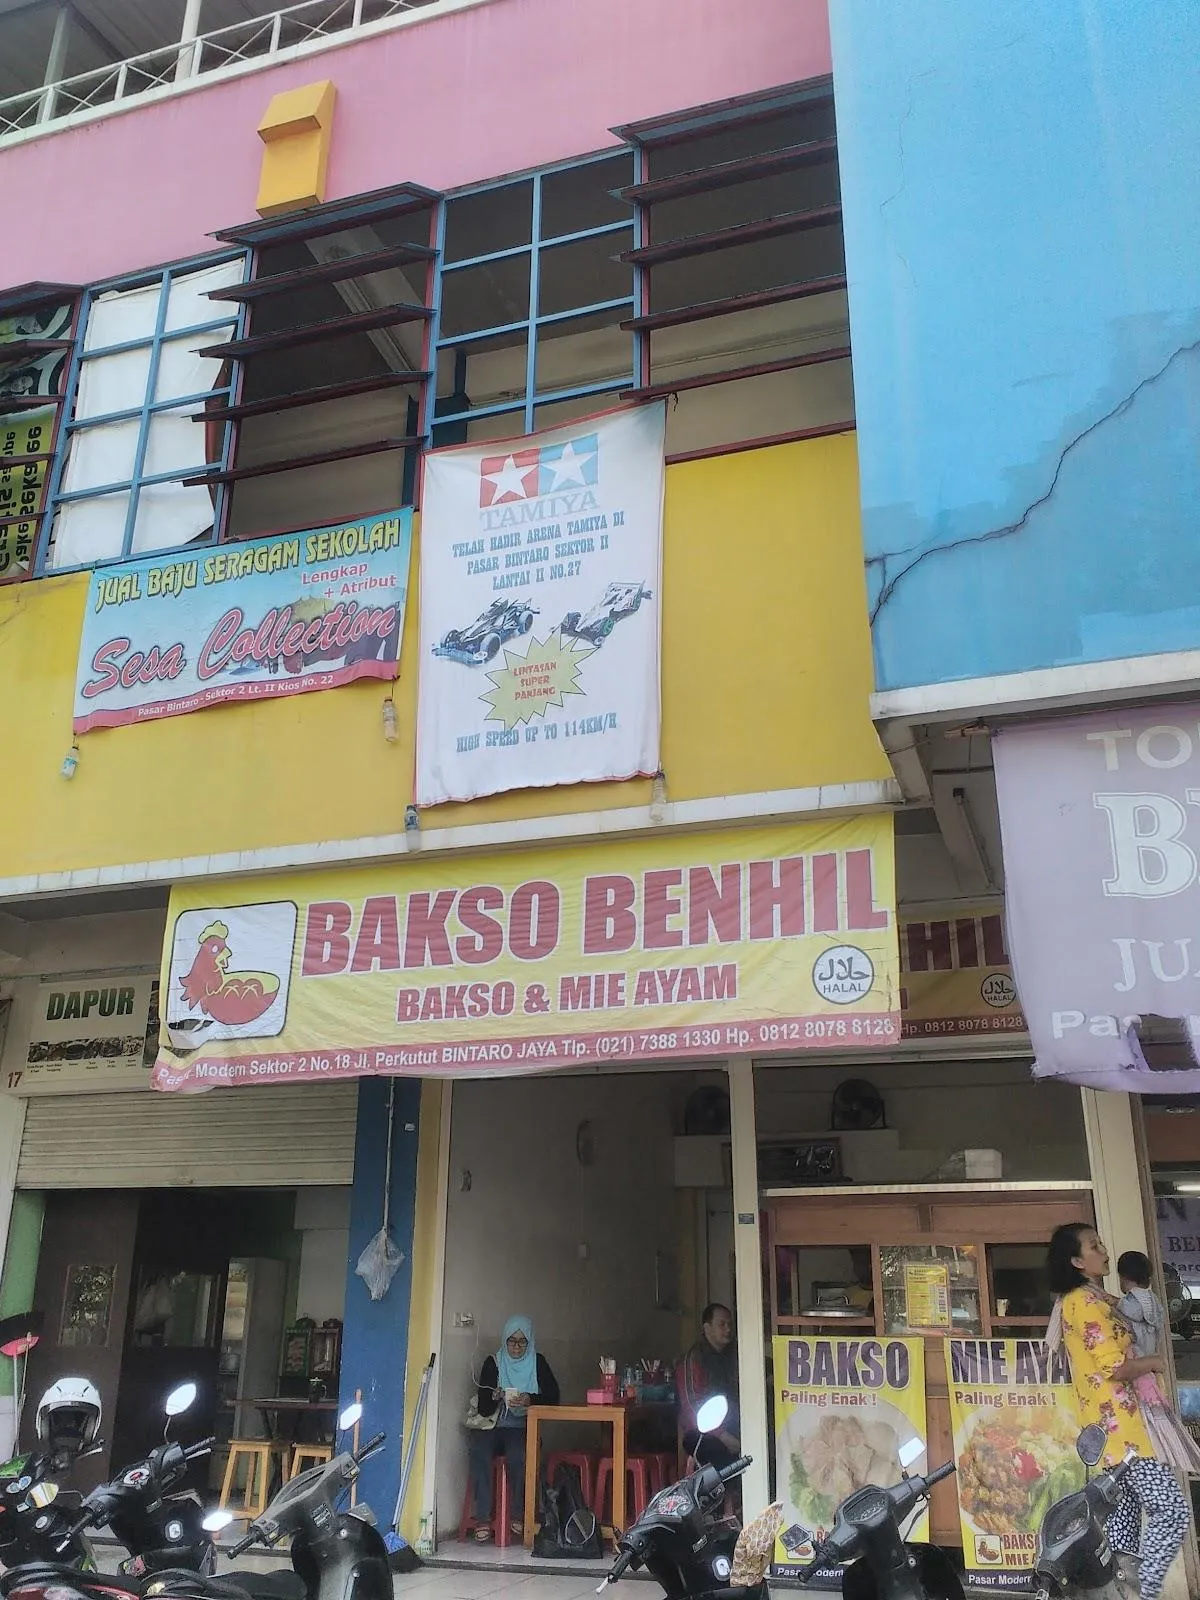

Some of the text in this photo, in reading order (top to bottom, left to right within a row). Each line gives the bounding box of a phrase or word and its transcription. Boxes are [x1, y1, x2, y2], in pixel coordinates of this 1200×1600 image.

[479, 490, 601, 531] TAMIYA
[452, 511, 625, 558] TELAH HADIR ARENA TAMIYA DI
[95, 518, 400, 614] JUAL BAJU SERAGAM SEKOLAH
[467, 534, 609, 575] PASAR BINTARO SEKTOR II
[302, 563, 368, 585] Lengkap
[340, 575, 397, 596] Atribut
[493, 560, 582, 590] LANTAI II NO.27
[82, 601, 397, 698] Sesa Collection
[513, 662, 557, 676] LINTASAN
[520, 675, 550, 687] SUPER
[138, 706, 164, 717] Pasar
[167, 699, 199, 712] Bintaro
[205, 687, 235, 700] Sektor
[238, 686, 245, 694] 2
[278, 682, 300, 692] Kios
[301, 676, 317, 687] No.
[321, 675, 334, 684] 22
[514, 687, 556, 700] PANJANG
[456, 733, 481, 752] HIGH
[485, 729, 519, 746] SPEED
[525, 726, 538, 742] UP
[544, 723, 557, 740] TO
[1086, 724, 1200, 771] TO
[1093, 788, 1200, 898] B
[301, 849, 888, 977] BAKSO BENHIL
[907, 915, 1010, 971] HIL
[818, 956, 870, 981] حلال
[1112, 938, 1200, 991] JU
[398, 963, 737, 1022] BAKSO & MIE AYAM
[823, 982, 866, 994] HALAL
[984, 980, 1014, 995] حلال
[987, 994, 1011, 1002] HALAL
[47, 986, 135, 1020] DAPUR
[925, 1021, 954, 1033] 0812
[958, 1018, 988, 1030] 8078
[993, 1016, 1023, 1028] 8128
[195, 1063, 245, 1079] Modern
[250, 1060, 293, 1075] Sektor
[299, 1059, 306, 1072] 2
[354, 1055, 370, 1069] Jl.
[375, 1050, 437, 1067] Perkutut
[441, 1044, 513, 1063] BINTARO
[517, 1041, 557, 1059] JAYA
[561, 1039, 590, 1057] Tlp.
[595, 1036, 635, 1056] (021)
[640, 1034, 677, 1050] 7388
[683, 1029, 720, 1047] 1330
[726, 1027, 753, 1047] Hp.
[760, 1023, 799, 1041] 0812
[804, 1019, 846, 1036] 8078
[852, 1018, 895, 1035] 8128
[8, 1072, 22, 1088] 17
[1167, 1236, 1200, 1252] BE
[788, 1340, 910, 1389] BAKSO
[951, 1340, 1073, 1385] MIE AYA
[781, 1390, 828, 1407] Paling
[831, 1392, 867, 1406] Enak
[955, 1391, 1003, 1408] Paling
[1008, 1392, 1047, 1406] Enak
[777, 1567, 844, 1577] Pas odern
[1005, 1554, 1028, 1566] MIE
[968, 1574, 996, 1585] Pasar
